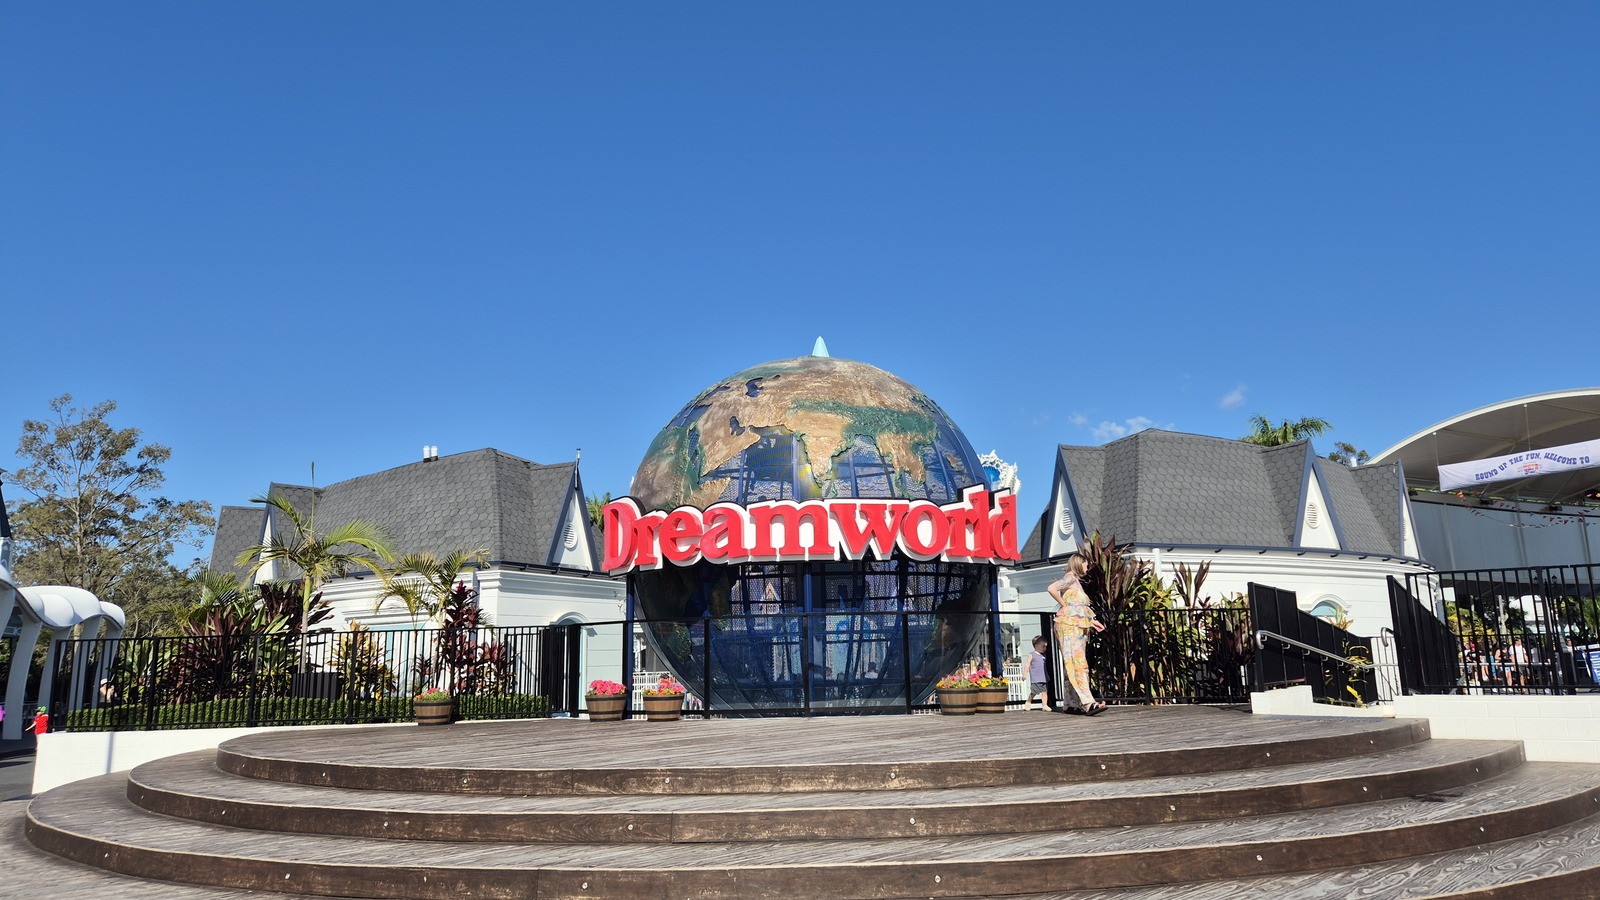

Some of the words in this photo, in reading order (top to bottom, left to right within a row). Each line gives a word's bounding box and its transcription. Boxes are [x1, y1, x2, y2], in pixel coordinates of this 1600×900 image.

[1475, 468, 1498, 480] ROUND
[1498, 462, 1507, 471] UP
[1509, 455, 1523, 465] THE
[1544, 452, 1577, 465] WELCOME
[1579, 456, 1590, 464] TO
[601, 488, 1021, 573] Dreamworld
